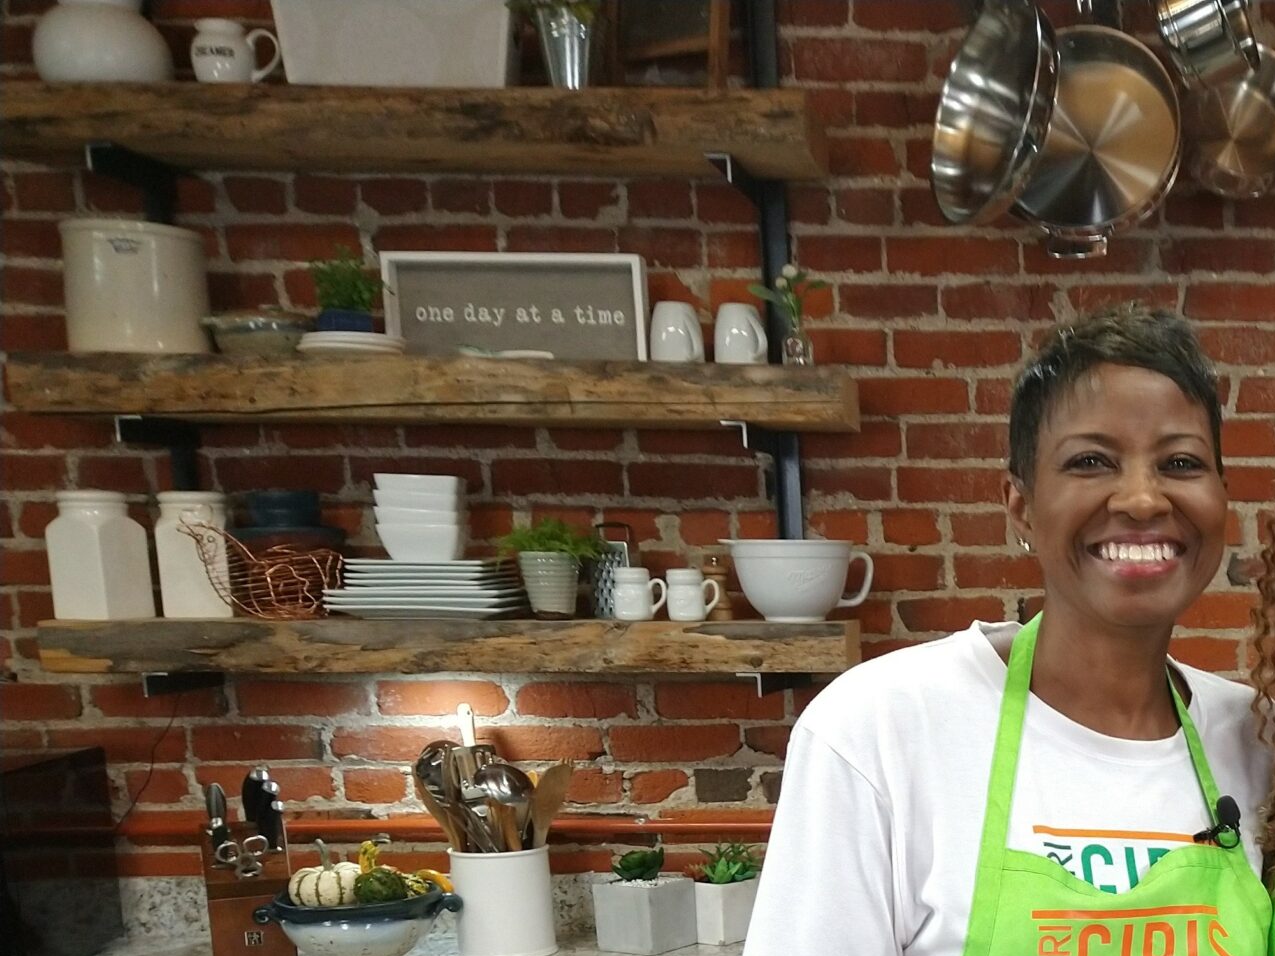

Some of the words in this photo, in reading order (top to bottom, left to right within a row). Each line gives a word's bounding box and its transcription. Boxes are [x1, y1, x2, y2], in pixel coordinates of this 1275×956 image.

[415, 304, 455, 322] one
[463, 302, 505, 326] day
[515, 304, 542, 323] at
[551, 307, 566, 324] a
[574, 304, 626, 326] time
